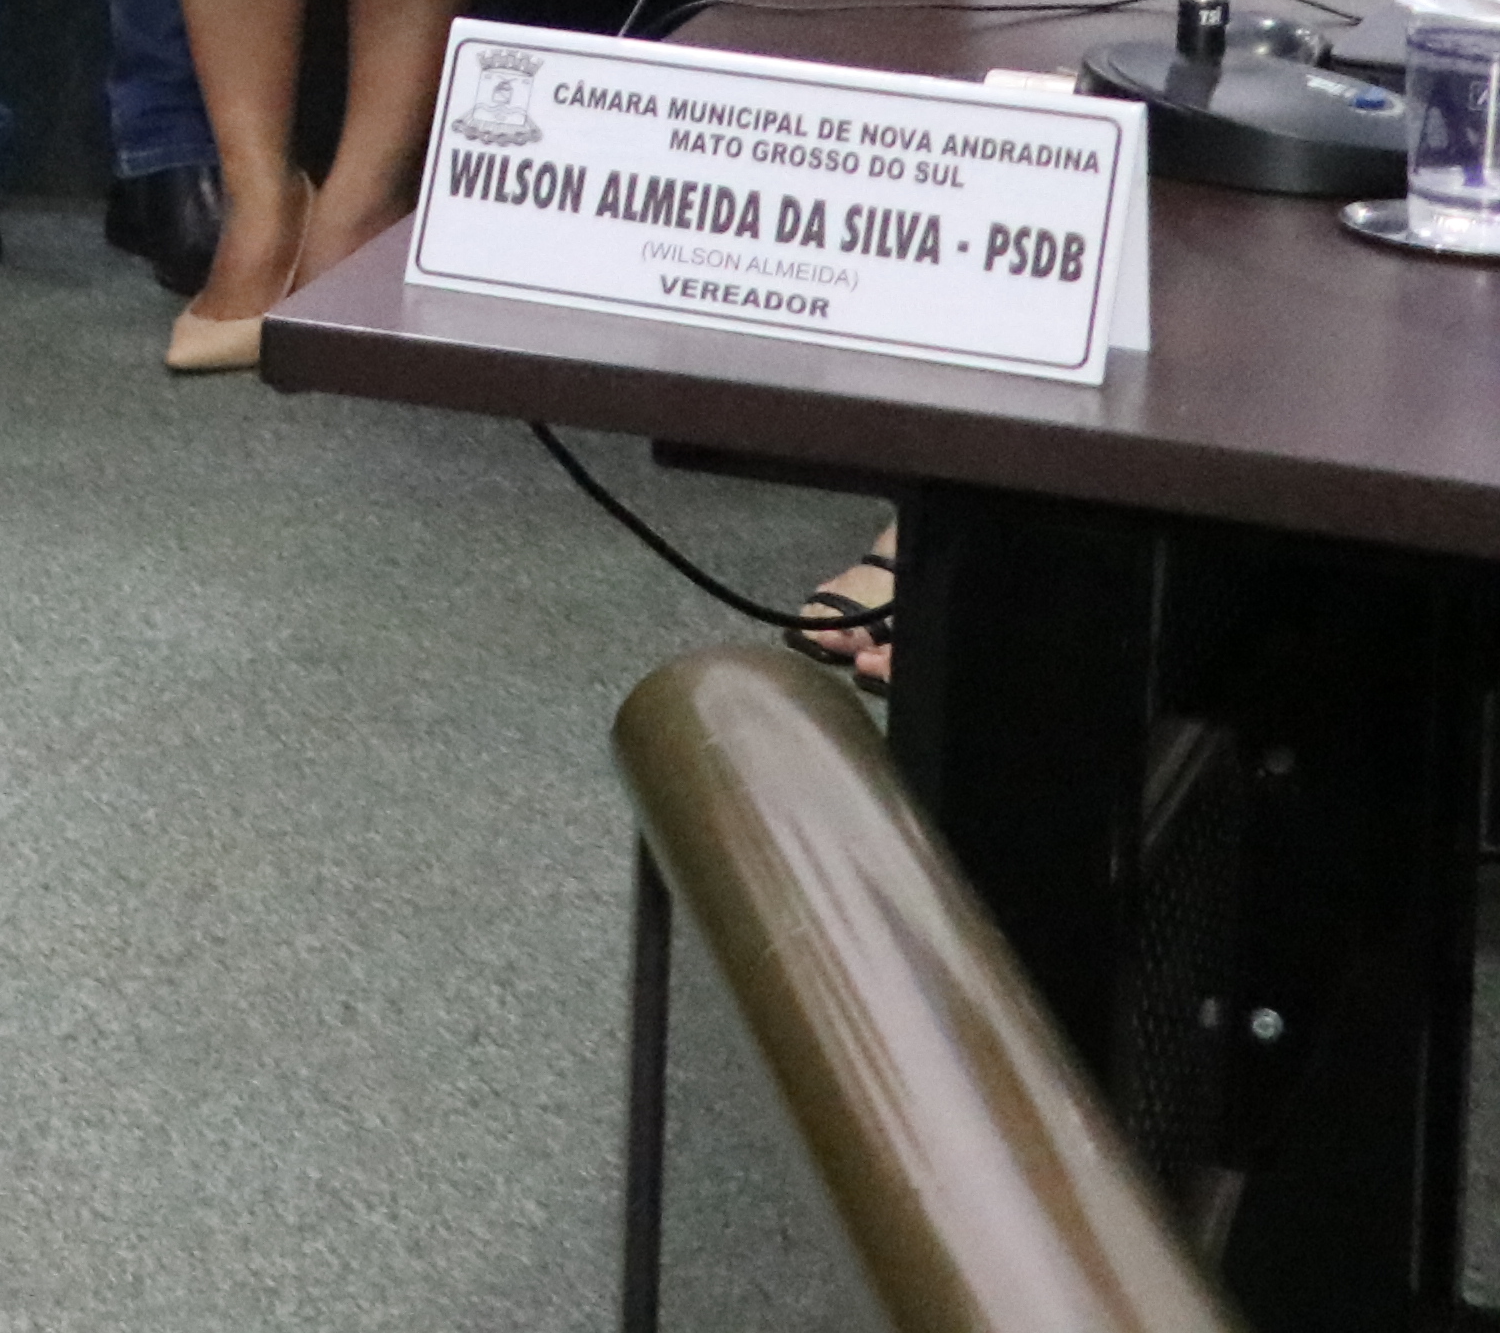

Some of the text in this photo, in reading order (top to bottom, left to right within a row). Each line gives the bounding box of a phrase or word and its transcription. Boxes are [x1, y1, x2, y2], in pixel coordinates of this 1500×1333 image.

[553, 80, 1100, 173] CÂMARA MUNICIPAL DE NOVA ANDRADINA
[669, 128, 965, 188] MATO GROSSO DO SUL
[449, 148, 1086, 283] WILSON ALMEIDA DA SILVA - PSDB
[642, 240, 859, 292] (WILSON ALMEIDA)
[660, 274, 830, 318] VEREADOR
